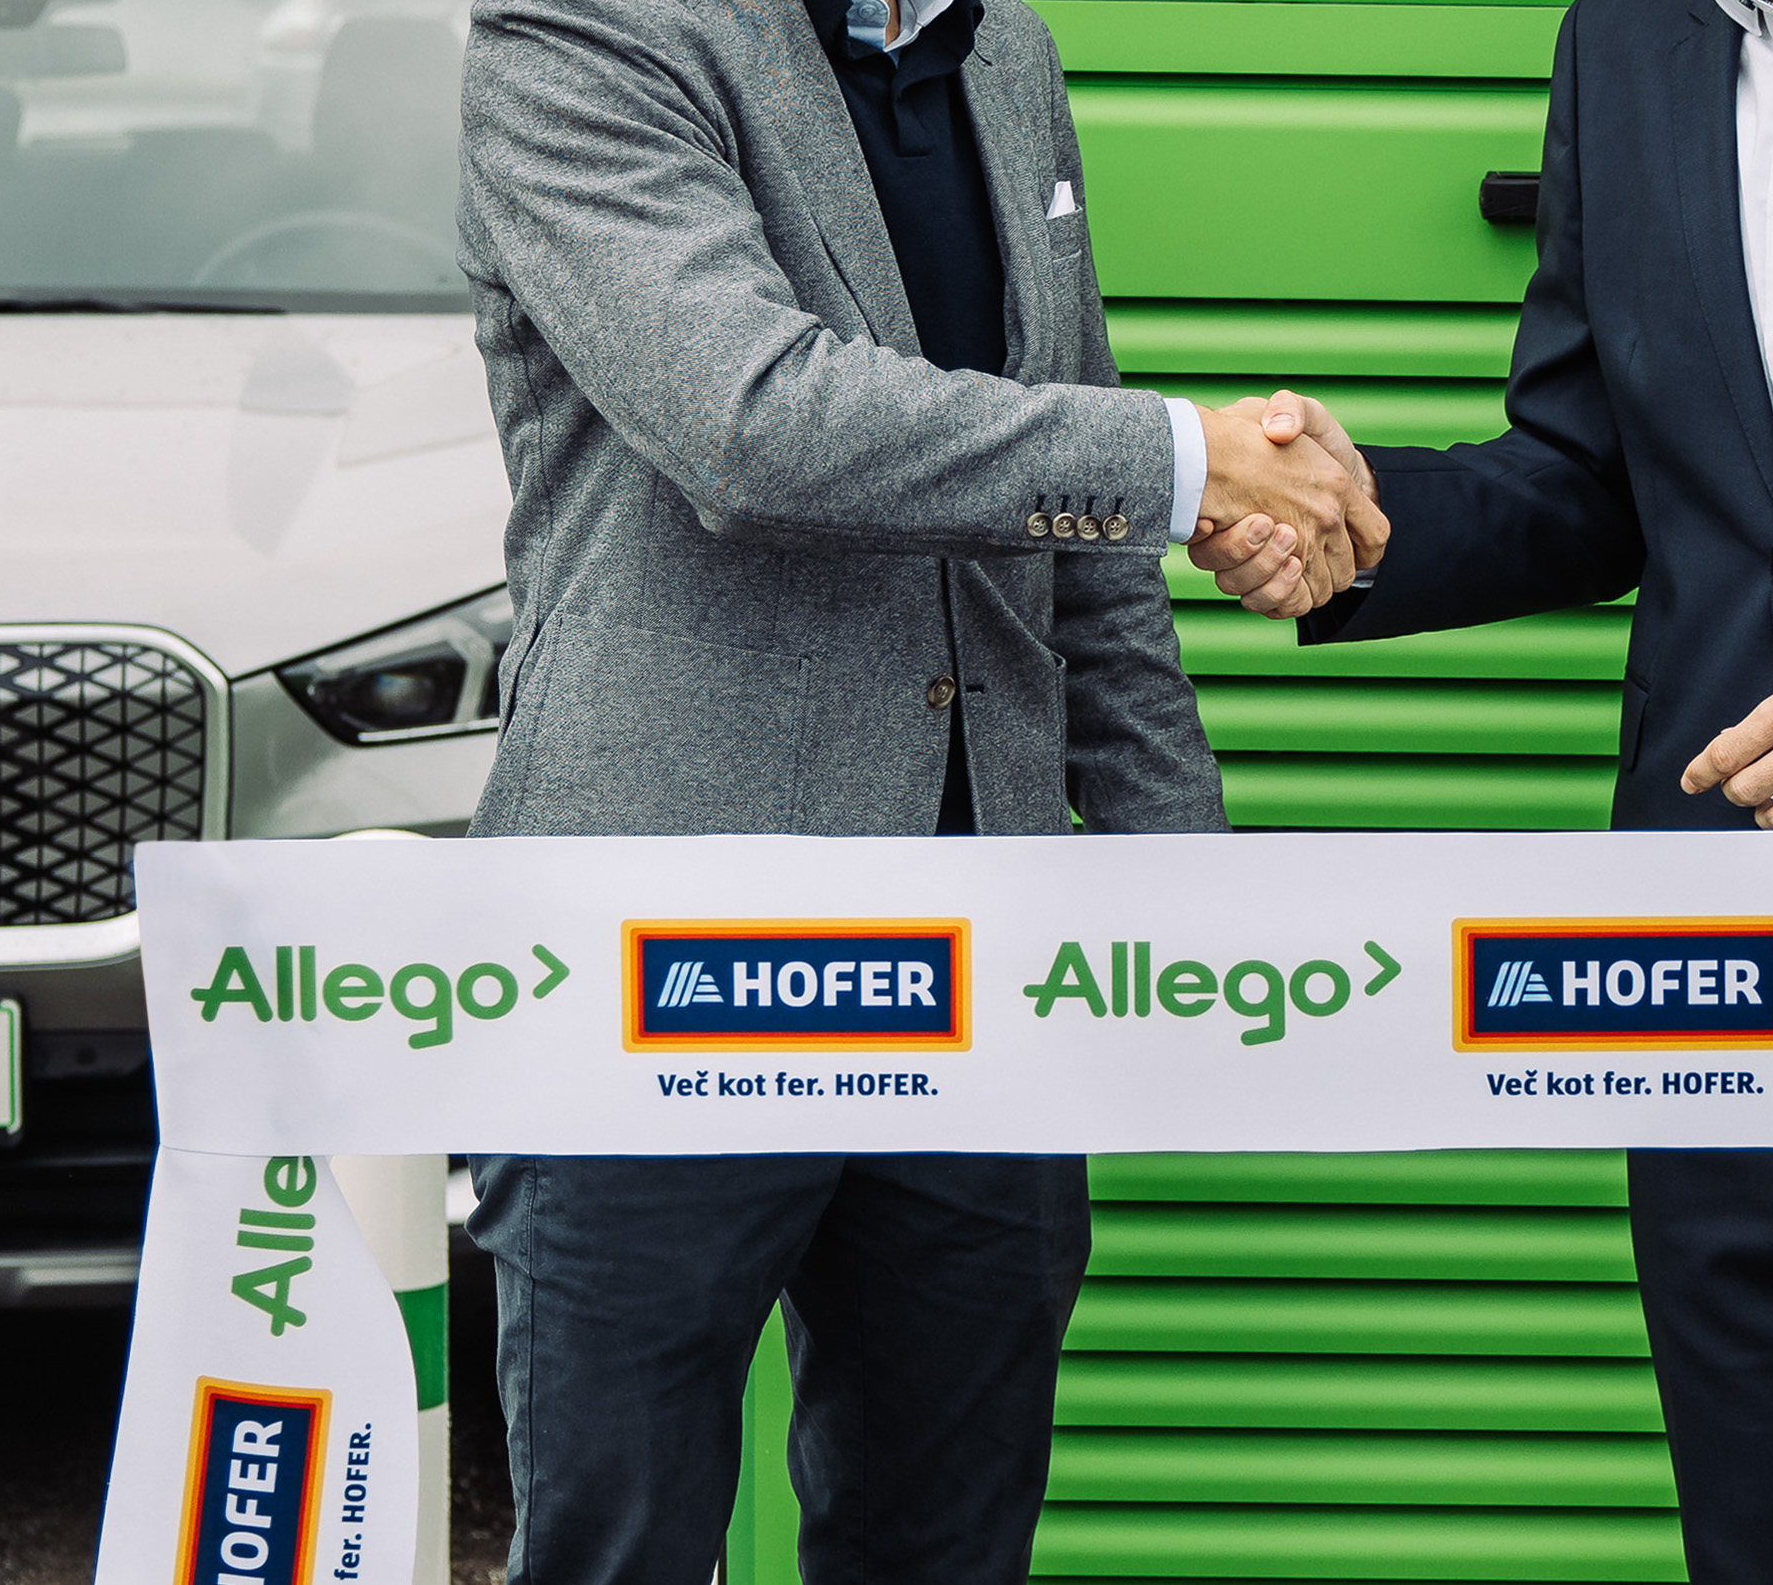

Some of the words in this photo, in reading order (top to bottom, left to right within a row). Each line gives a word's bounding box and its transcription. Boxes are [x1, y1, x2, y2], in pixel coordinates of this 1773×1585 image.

[190, 945, 518, 1050] Allego
[733, 960, 937, 1008] HOFER
[1023, 941, 1351, 1046] Allego
[1563, 959, 1762, 1007] HOFER
[657, 1069, 710, 1098] Več
[718, 1073, 767, 1098] kot
[775, 1072, 825, 1098] fer.
[835, 1073, 939, 1098] HOFER.
[1486, 1069, 1539, 1098] Več
[1546, 1071, 1595, 1098] kot
[1603, 1071, 1652, 1097] fer.
[1662, 1071, 1765, 1096] HOFER.
[231, 1156, 317, 1337] Alle
[342, 1422, 373, 1524] HOFER.
[334, 1533, 363, 1581] fer.
